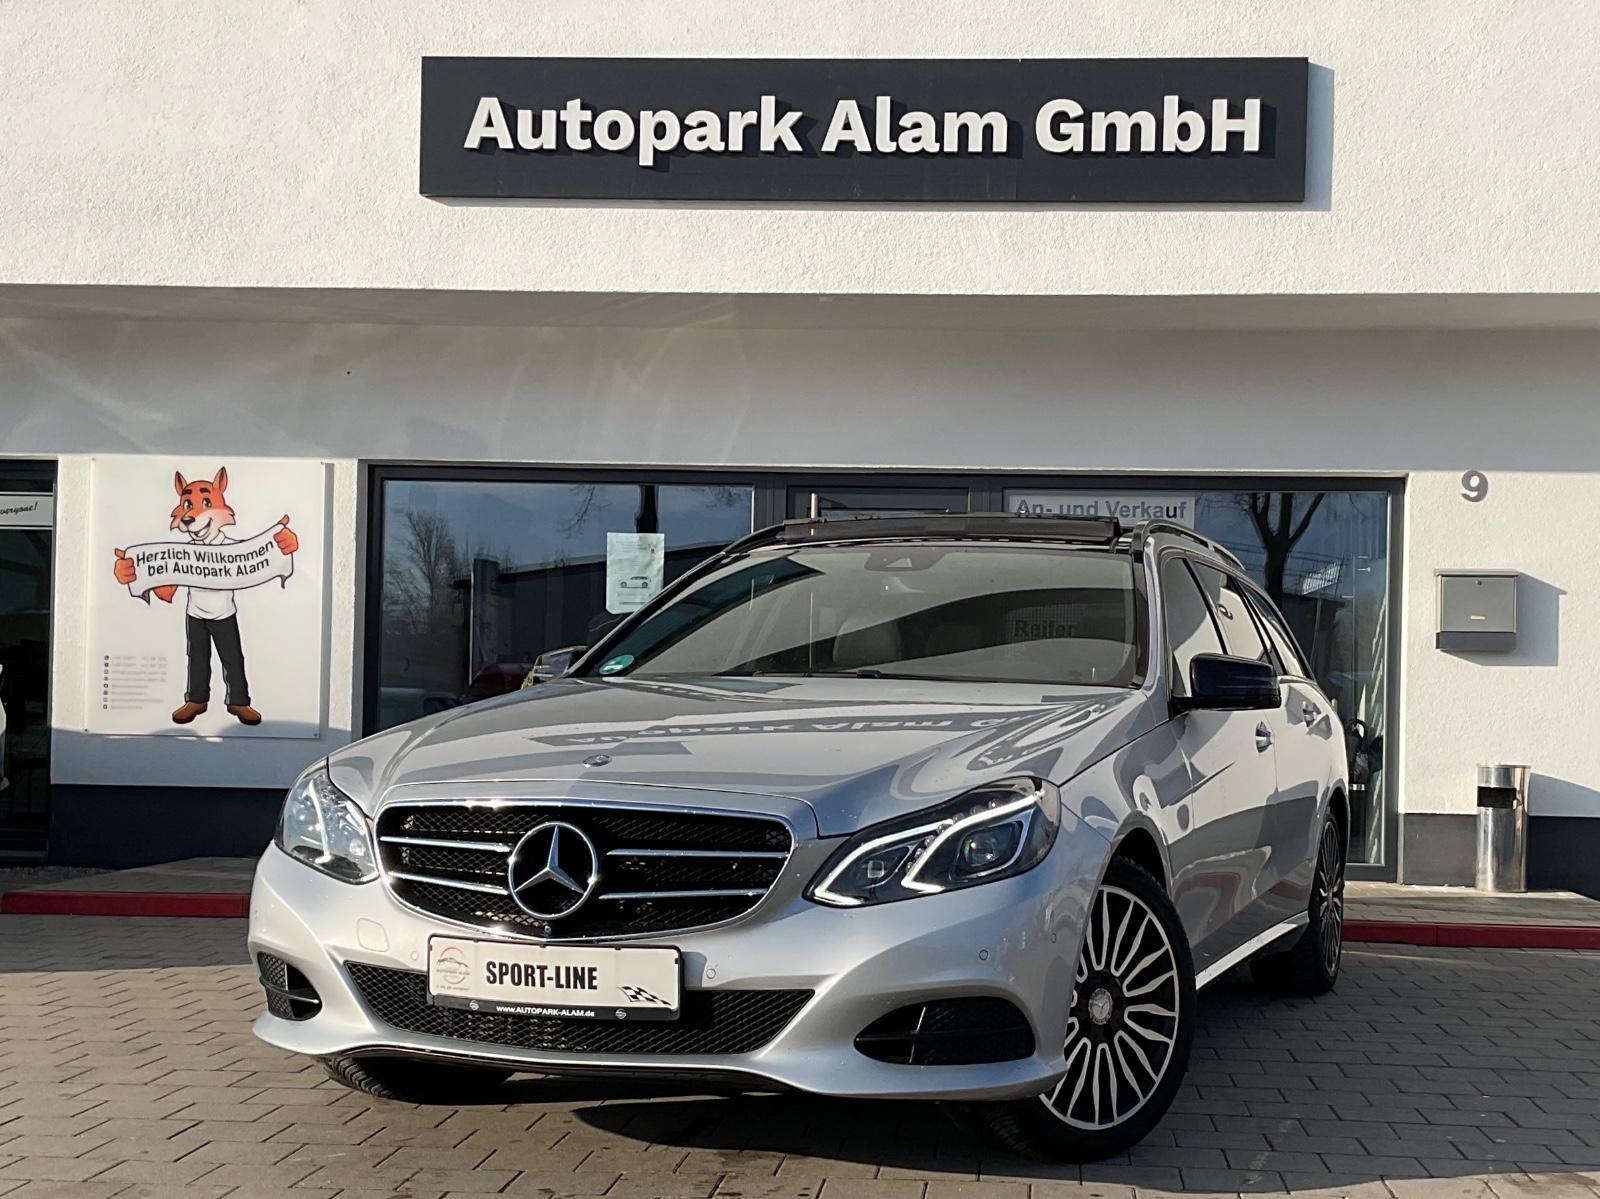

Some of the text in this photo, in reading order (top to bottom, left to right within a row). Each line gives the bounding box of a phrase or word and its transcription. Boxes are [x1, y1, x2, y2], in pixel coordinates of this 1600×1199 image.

[464, 95, 1262, 167] Autopark Alam GmbH
[1461, 469, 1489, 502] 9
[1017, 499, 1187, 518] An- und Verkauf
[136, 540, 274, 567] Herzlich Willkommen
[148, 558, 269, 579] bei Autopark Alam
[486, 960, 598, 990] SPORT-LINE
[496, 1005, 595, 1017] www.AUTOPARK-ALAM.de
